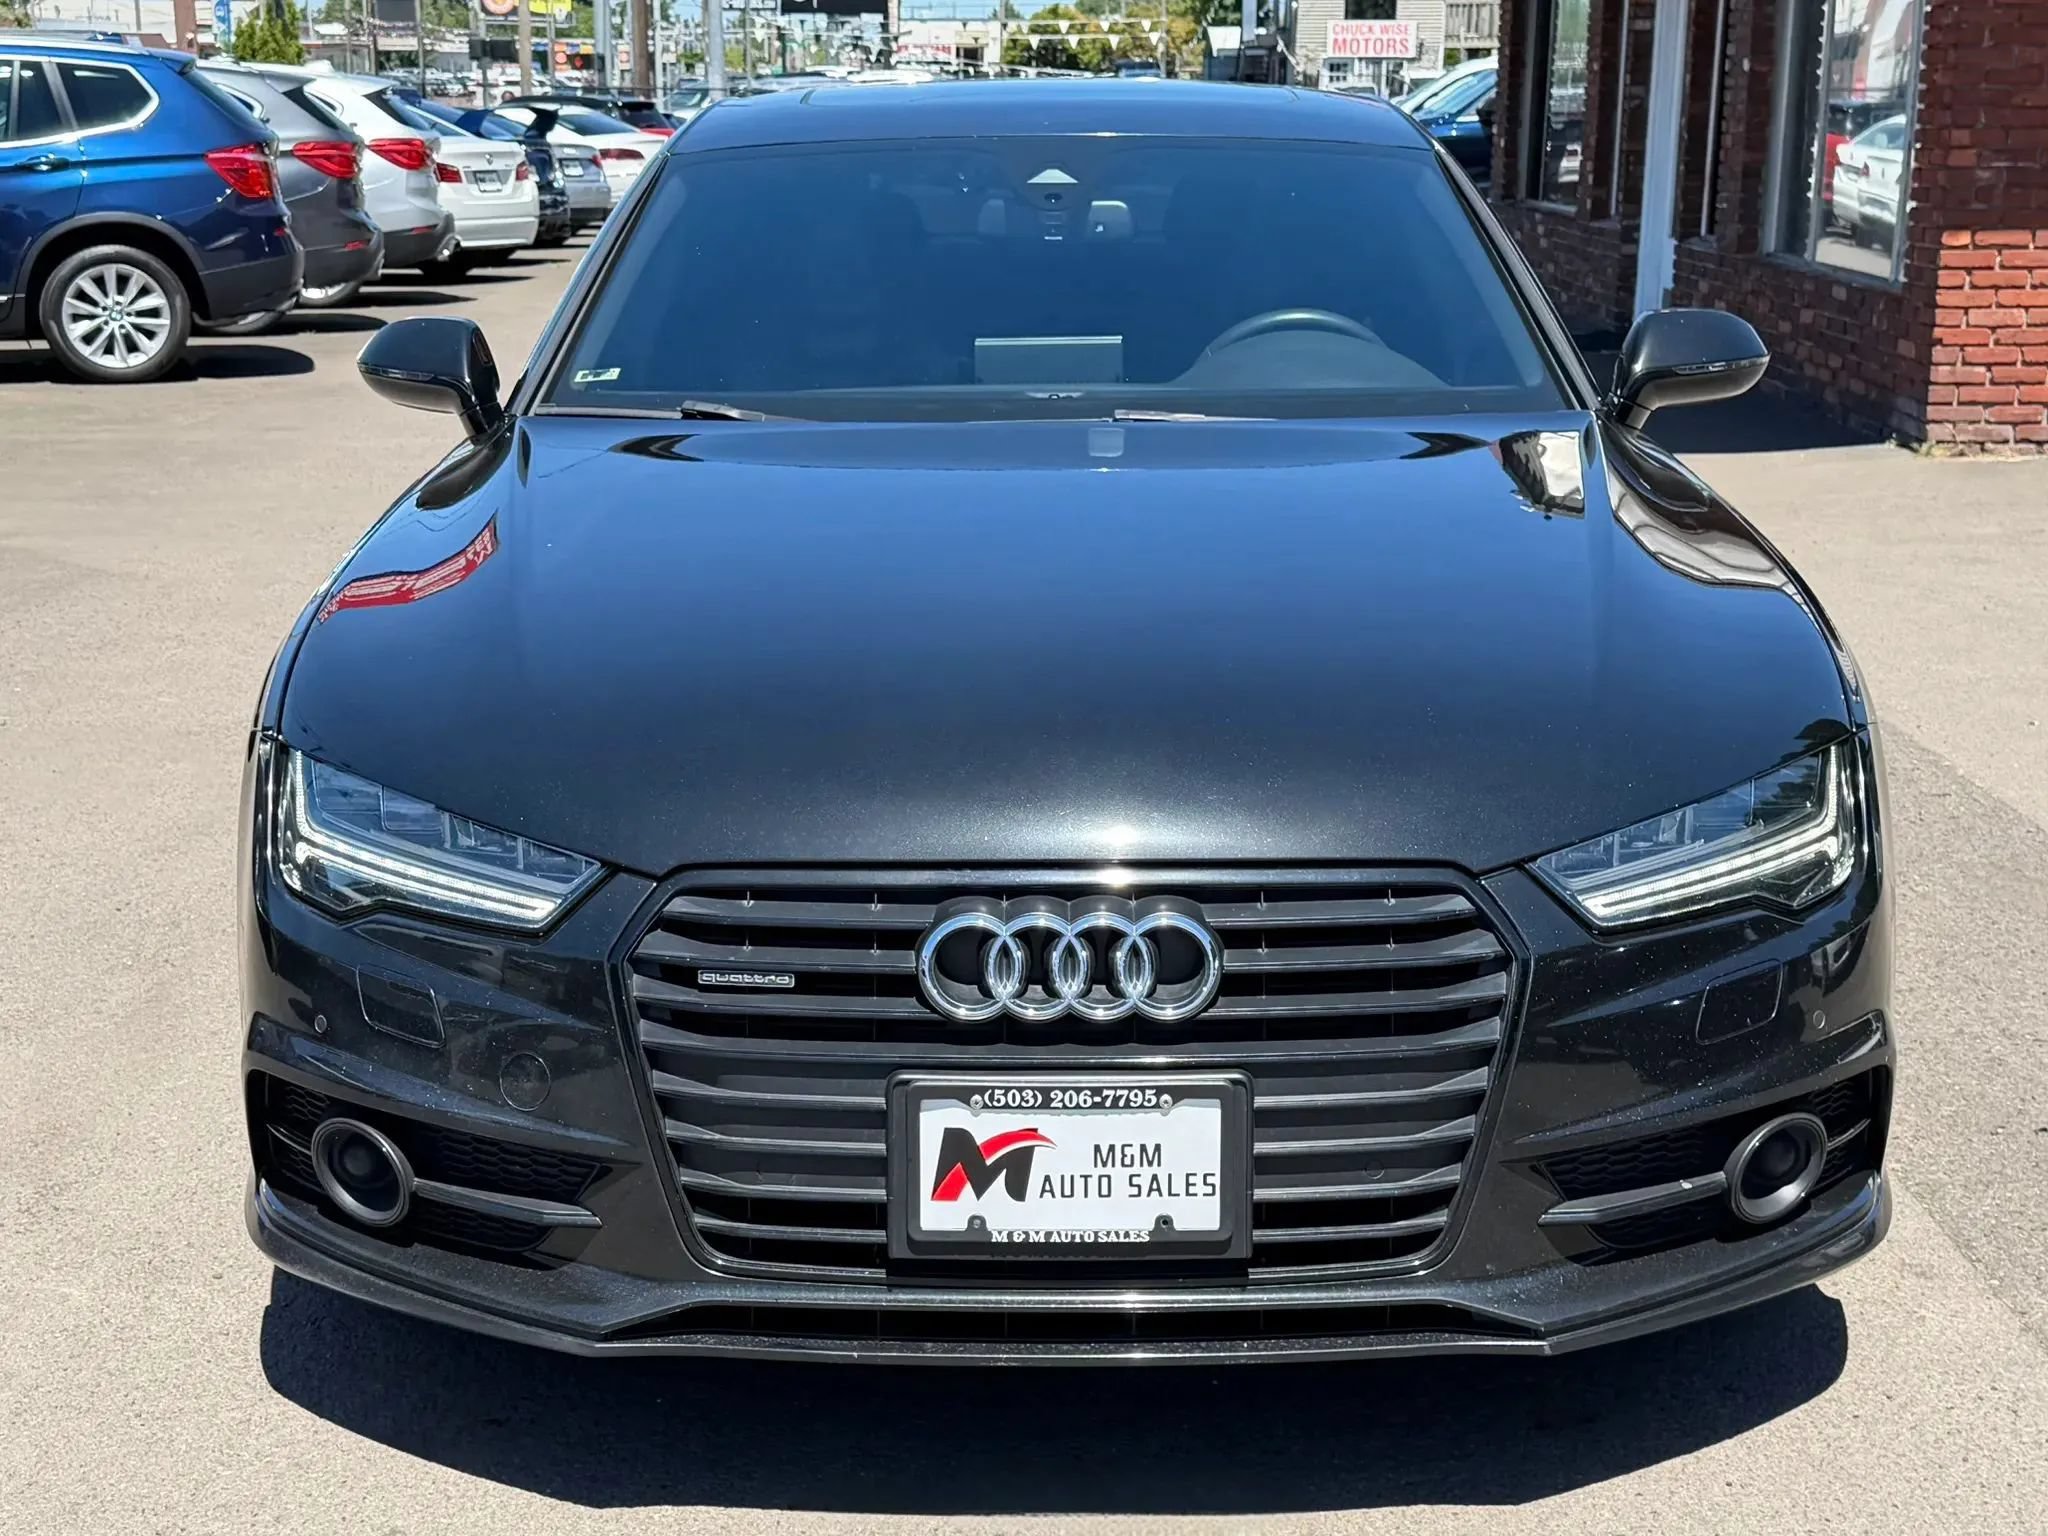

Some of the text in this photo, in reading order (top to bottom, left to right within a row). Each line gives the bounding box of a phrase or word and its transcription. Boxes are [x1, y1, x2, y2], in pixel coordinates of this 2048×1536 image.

[1332, 23, 1409, 35] CHUCK WISE
[1332, 38, 1409, 55] MOTORS
[702, 973, 790, 984] quattro
[983, 1088, 1158, 1109] (503) 206-7795
[1093, 1143, 1162, 1168] M&M
[1039, 1172, 1217, 1199] AUTO SALES
[991, 1230, 1151, 1243] M & M AUTO SALES
